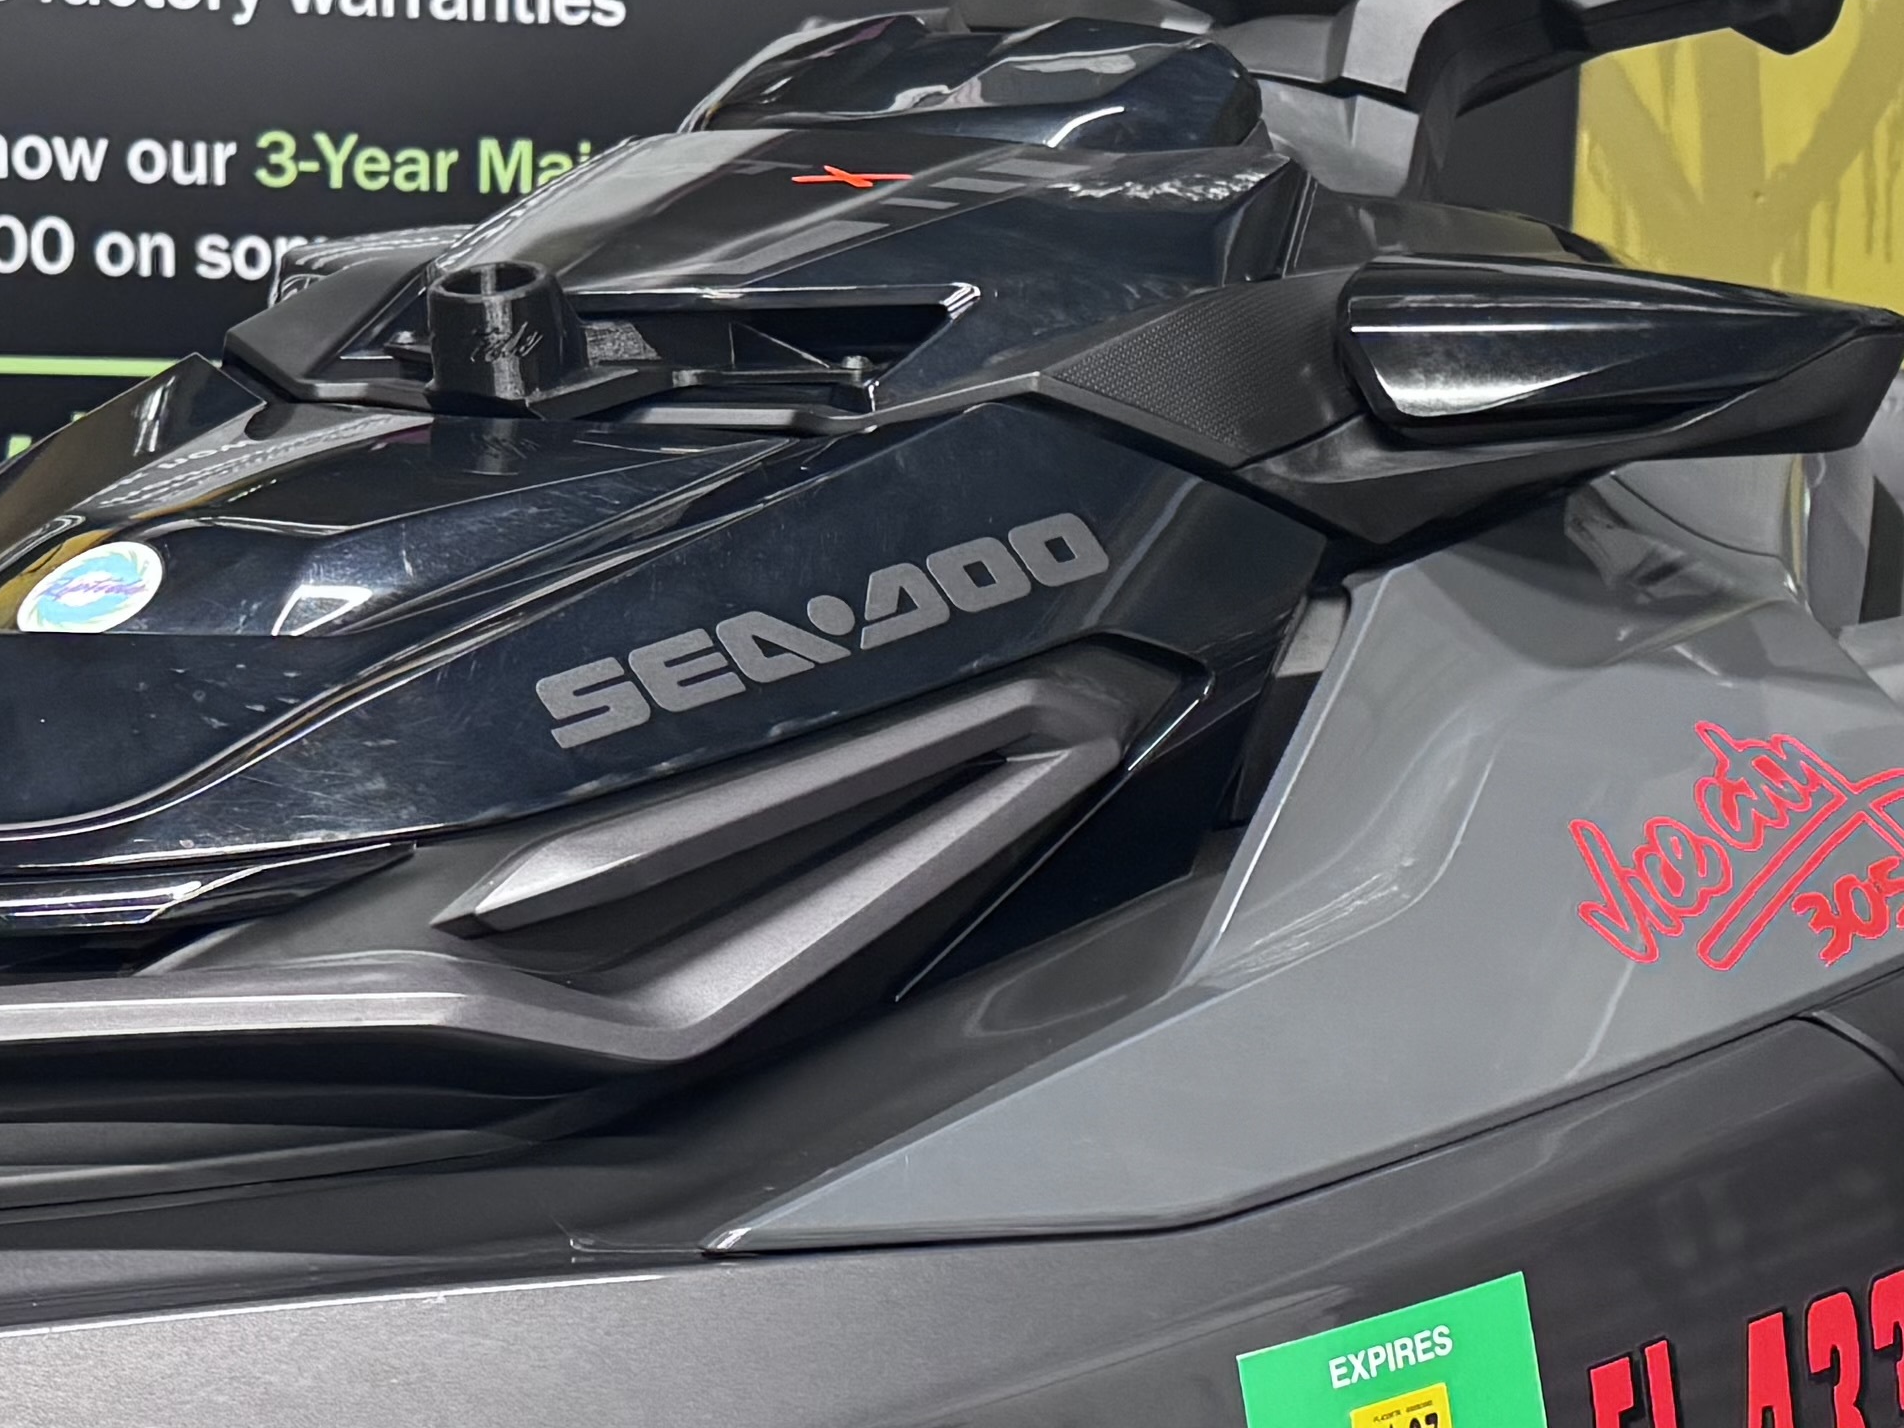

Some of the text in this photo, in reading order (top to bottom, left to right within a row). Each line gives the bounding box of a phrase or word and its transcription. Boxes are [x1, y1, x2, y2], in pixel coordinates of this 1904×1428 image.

[125, 137, 239, 188] our
[253, 128, 461, 195] 3-Year
[92, 229, 177, 281] on
[1328, 1325, 1454, 1389] EXPIRES
